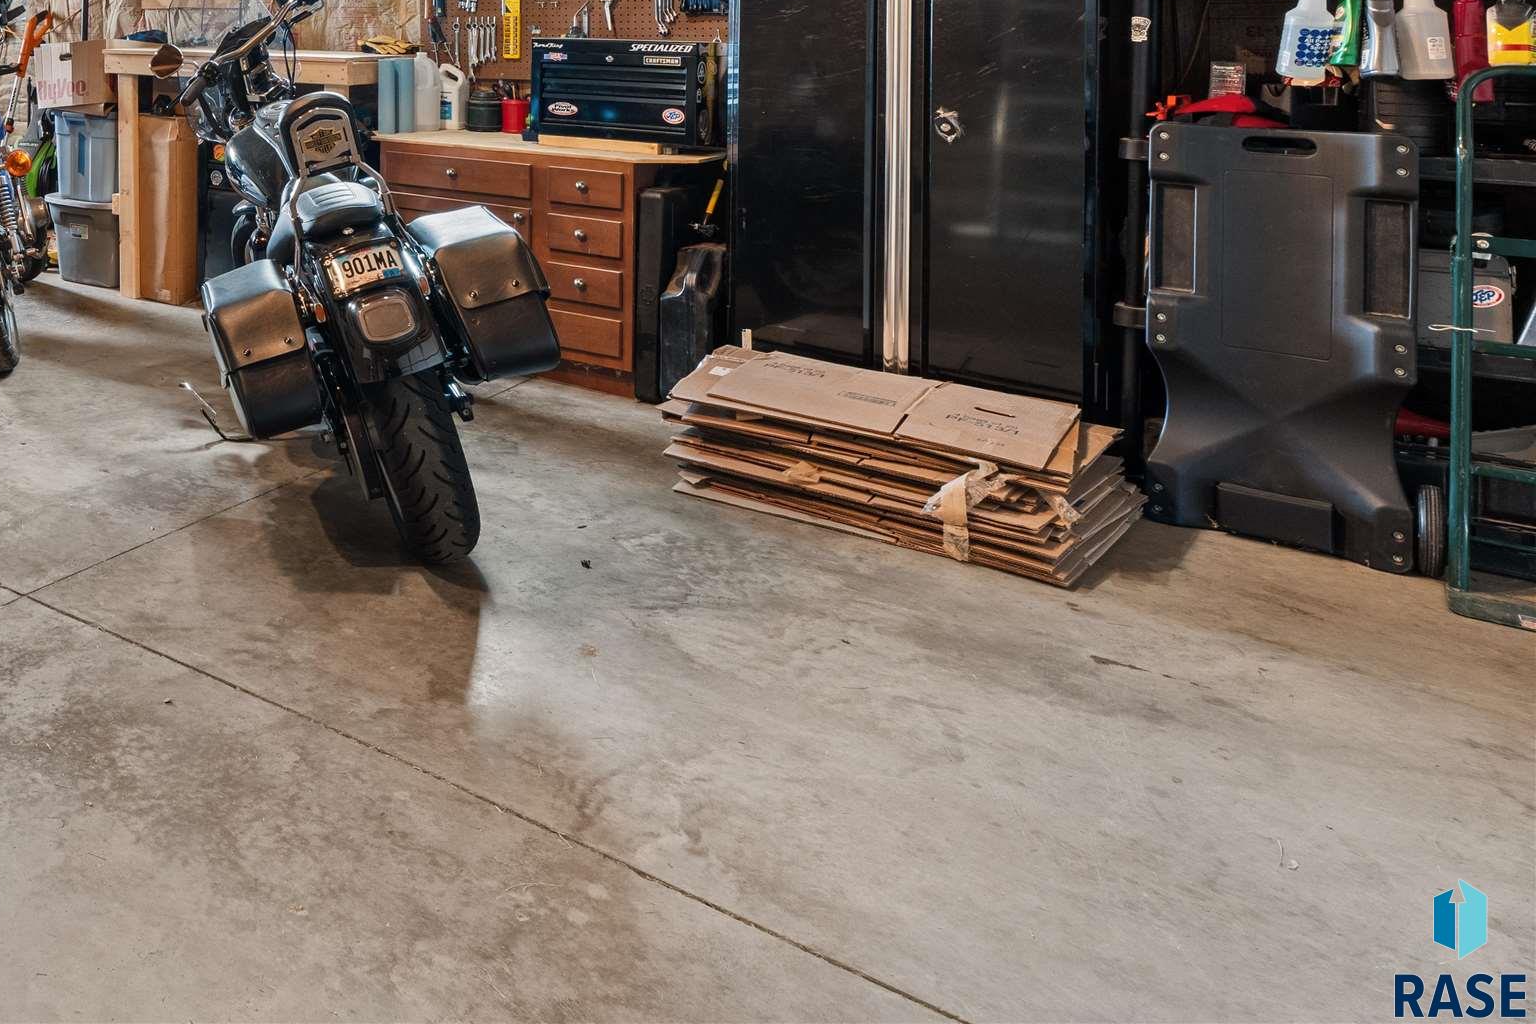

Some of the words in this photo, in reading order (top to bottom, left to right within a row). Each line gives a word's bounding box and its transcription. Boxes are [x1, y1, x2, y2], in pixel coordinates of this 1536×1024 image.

[629, 43, 695, 53] SPECIALIZED
[645, 57, 679, 65] CRAFTSMAN
[342, 249, 398, 279] 901MA
